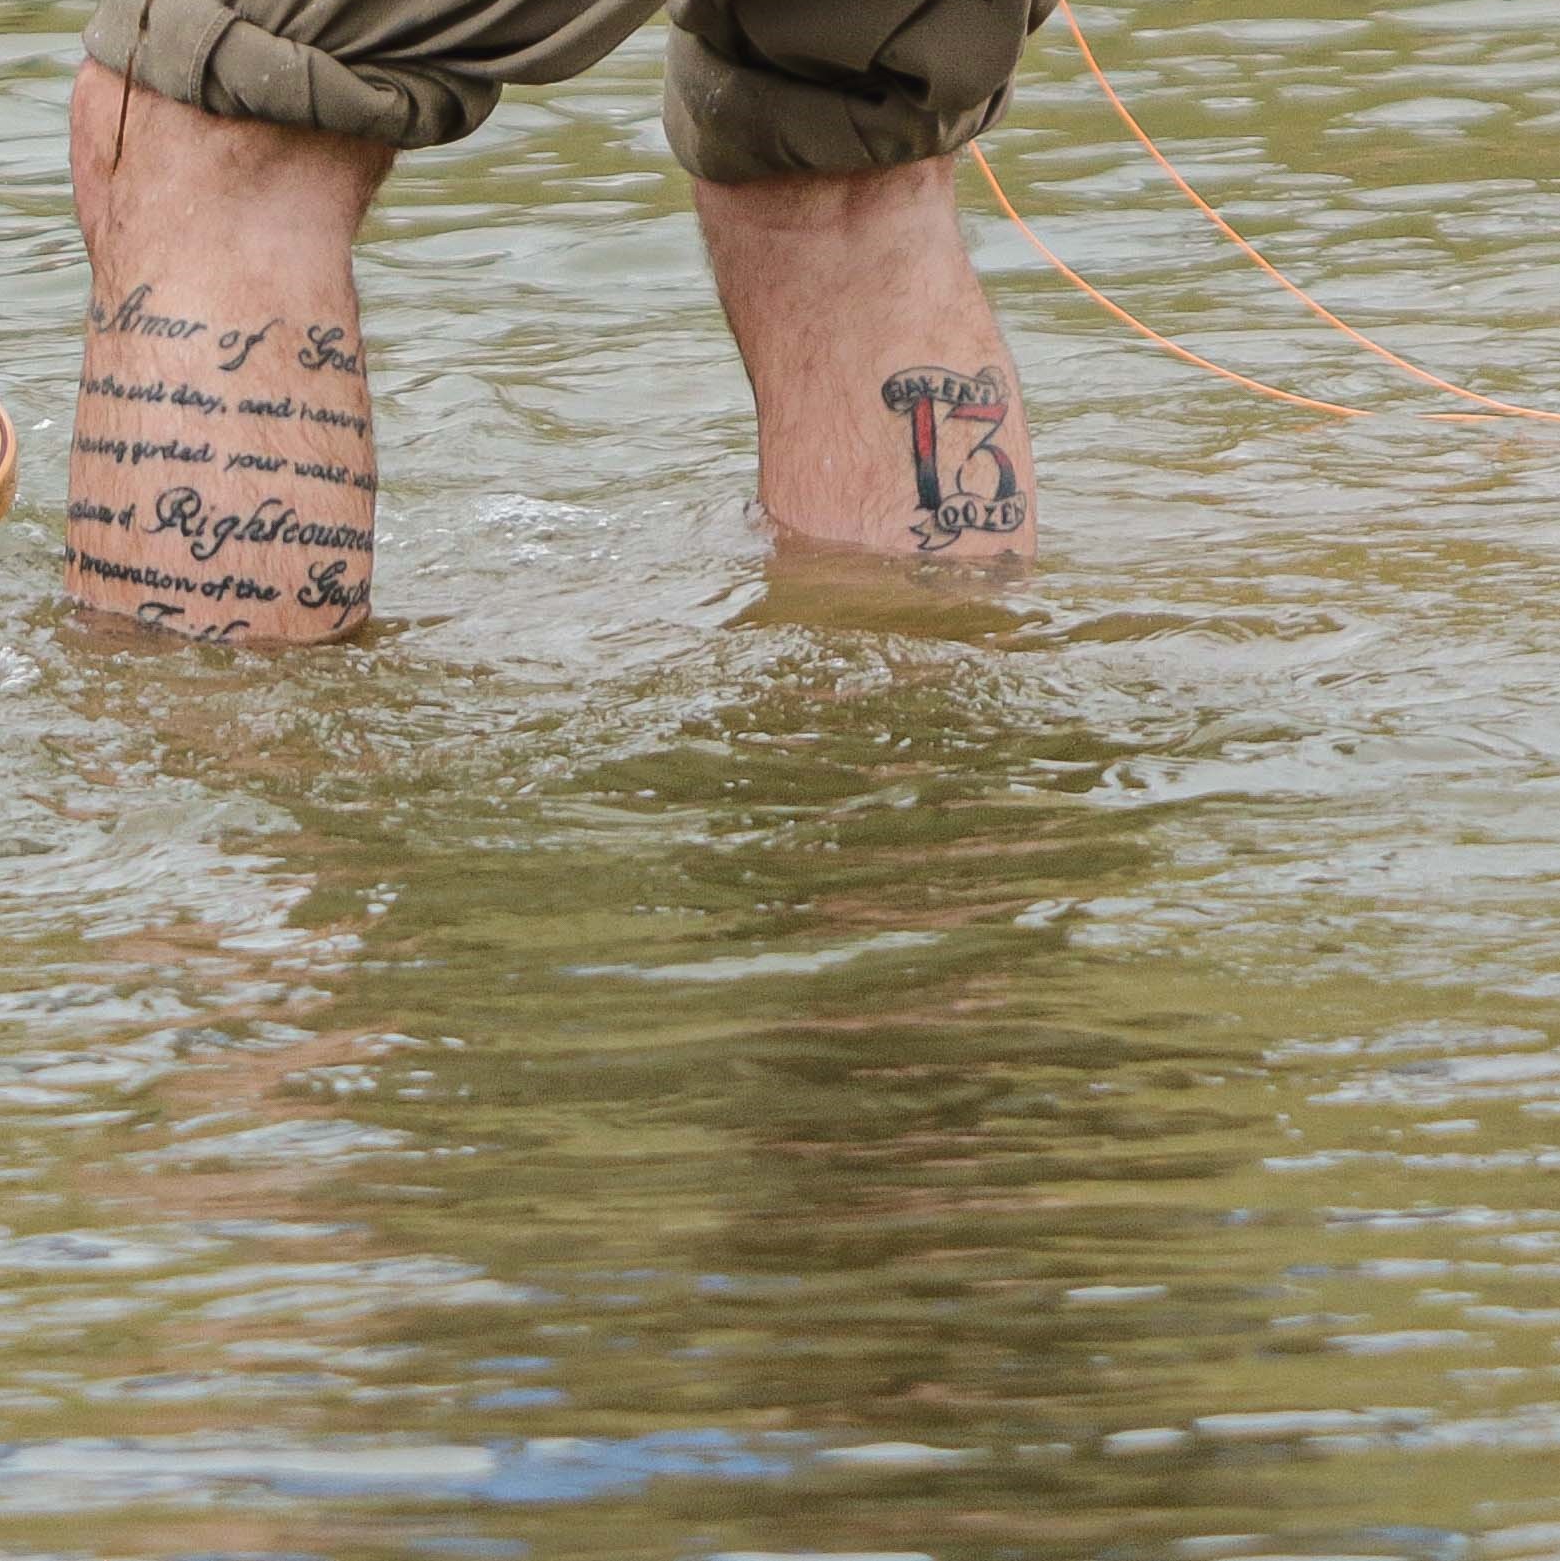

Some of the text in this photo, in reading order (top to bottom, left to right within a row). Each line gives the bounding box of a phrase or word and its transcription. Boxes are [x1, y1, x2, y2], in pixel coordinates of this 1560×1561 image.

[98, 283, 207, 339] Armor
[219, 318, 280, 372] of
[238, 397, 296, 419] and
[300, 402, 368, 438] having
[223, 451, 288, 473] your
[294, 461, 349, 486] waist
[912, 396, 1018, 511] 13
[941, 498, 1026, 529] DOZEN
[79, 551, 196, 594] preparation
[200, 575, 234, 601] of
[235, 576, 281, 602] the
